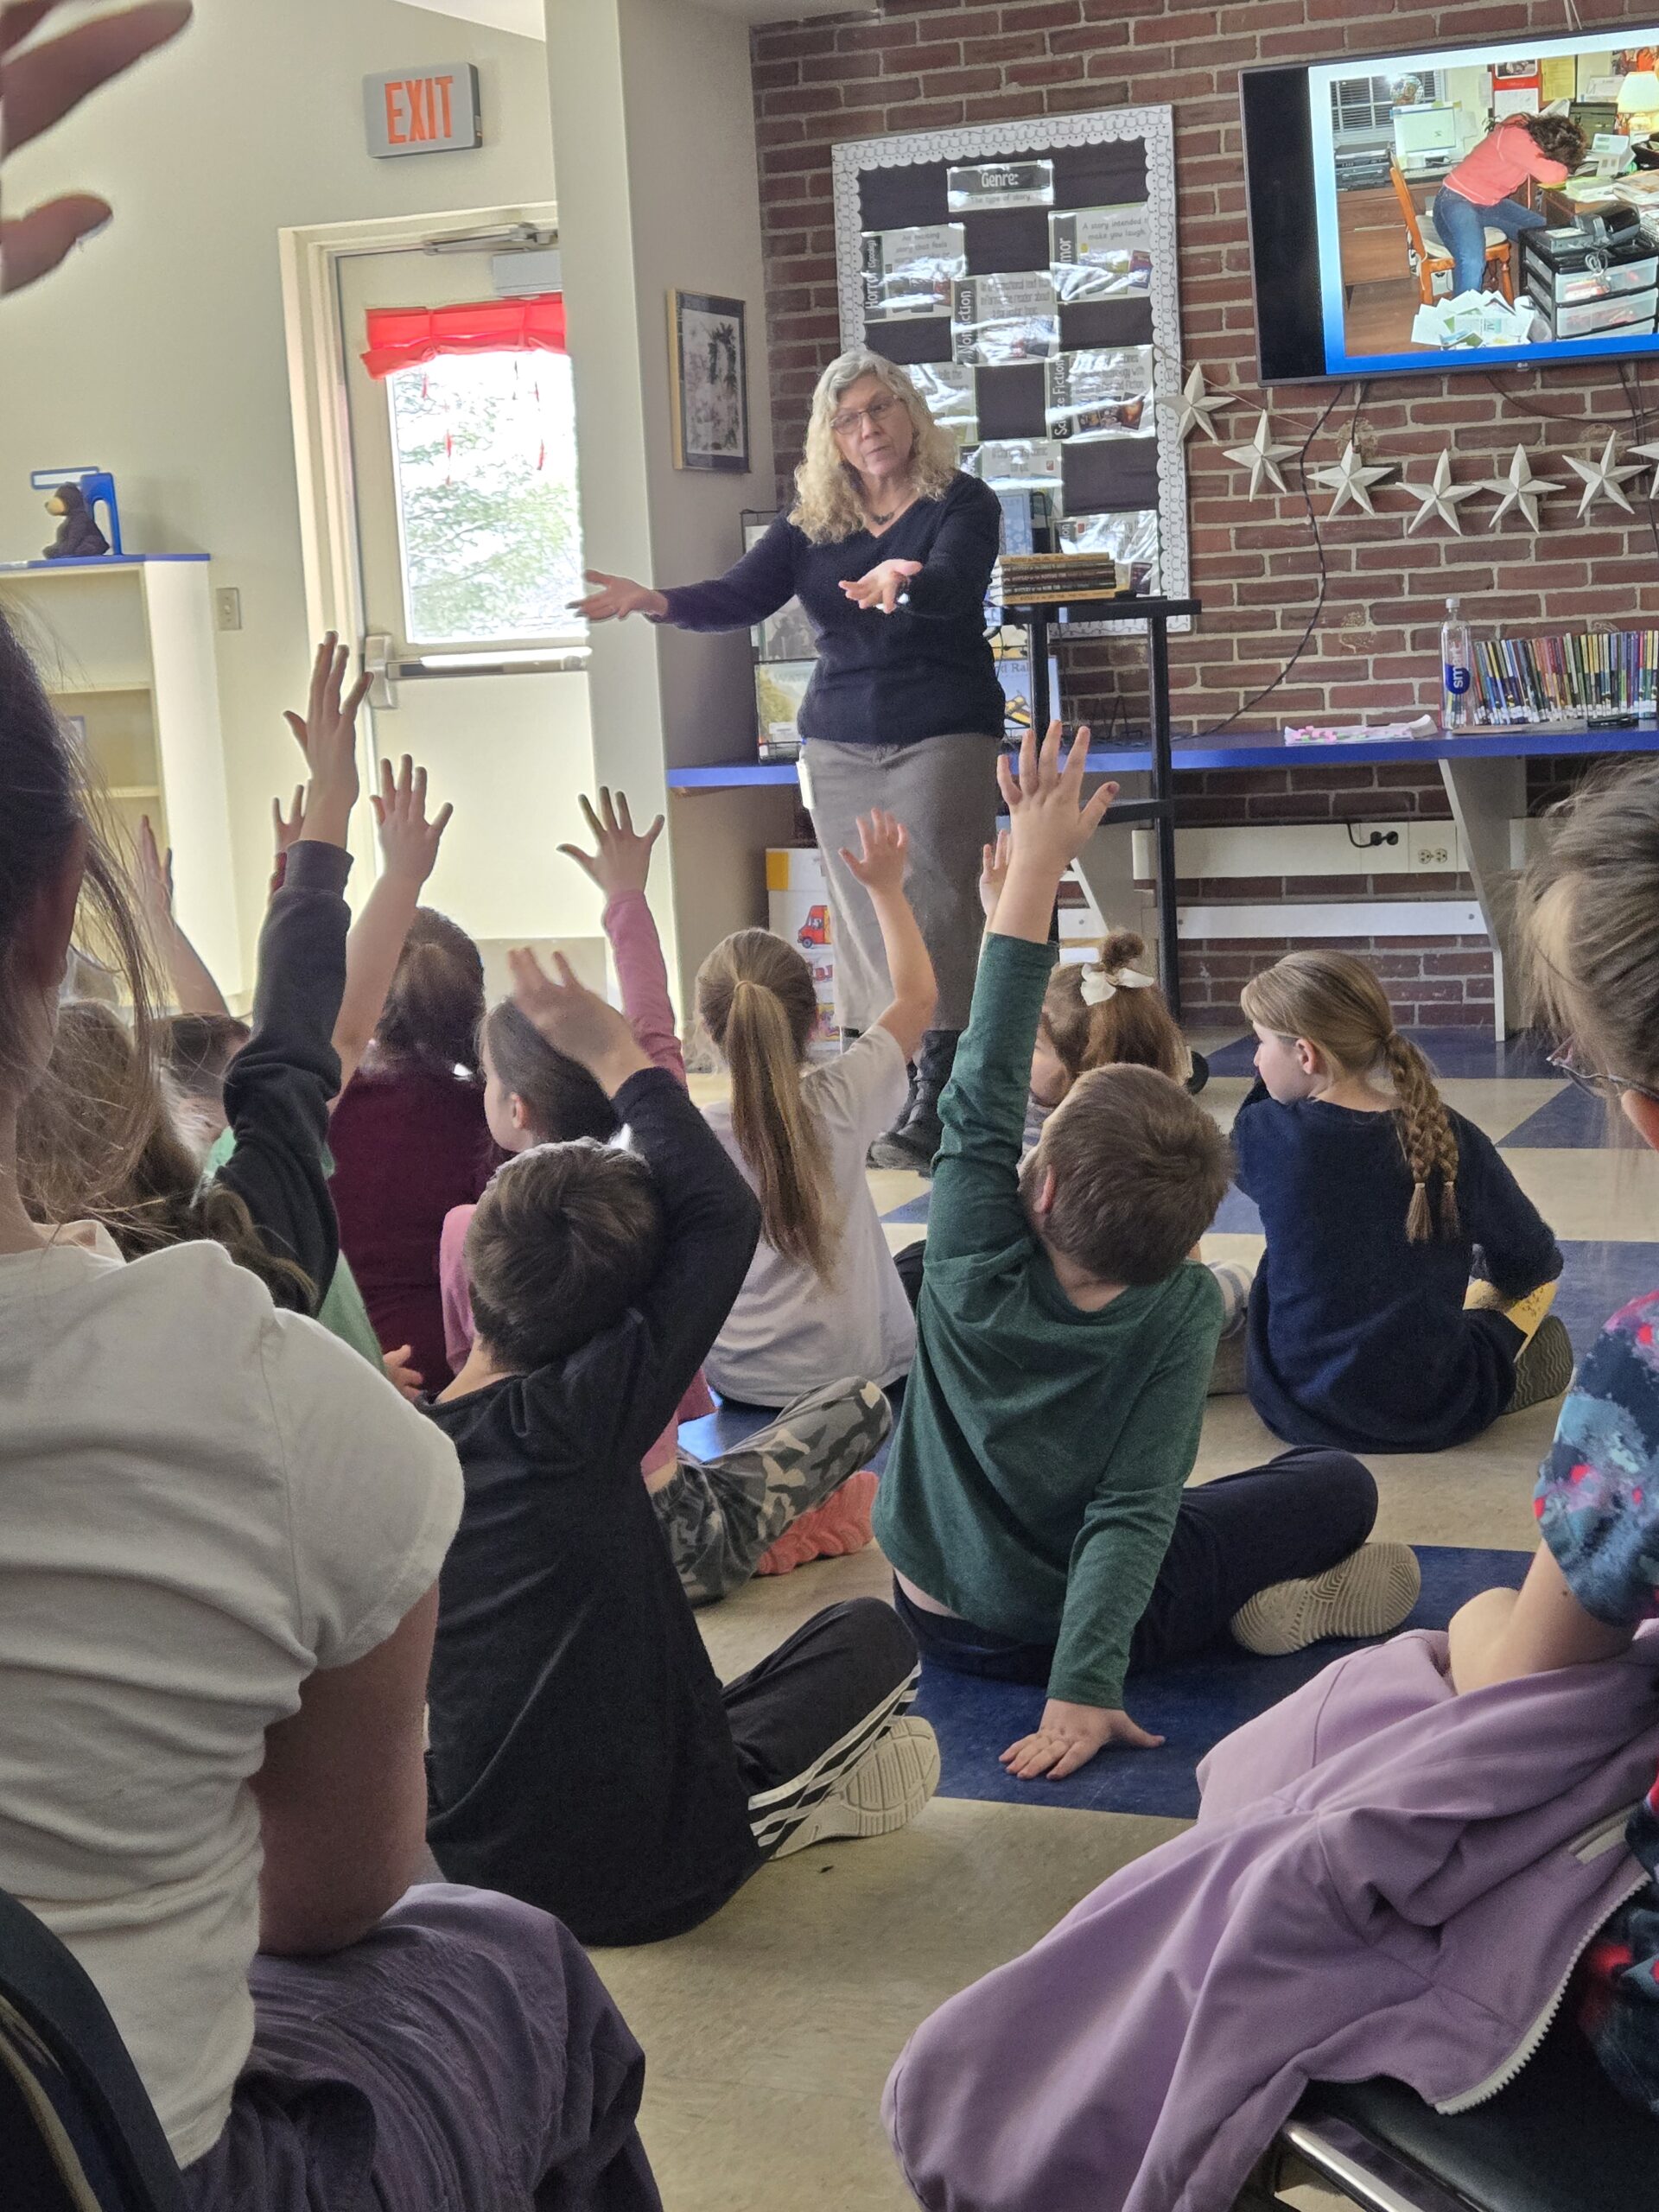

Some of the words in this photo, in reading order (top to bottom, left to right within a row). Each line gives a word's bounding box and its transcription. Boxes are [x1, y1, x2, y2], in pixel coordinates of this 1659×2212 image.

[385, 75, 454, 144] EXIT
[981, 172, 1019, 188] Genre:
[1091, 221, 1109, 230] story
[1112, 219, 1141, 227] intended
[1110, 232, 1122, 240] you
[957, 290, 973, 354] Noniction
[1052, 359, 1065, 395] Fiction
[1450, 641, 1464, 689] smart
